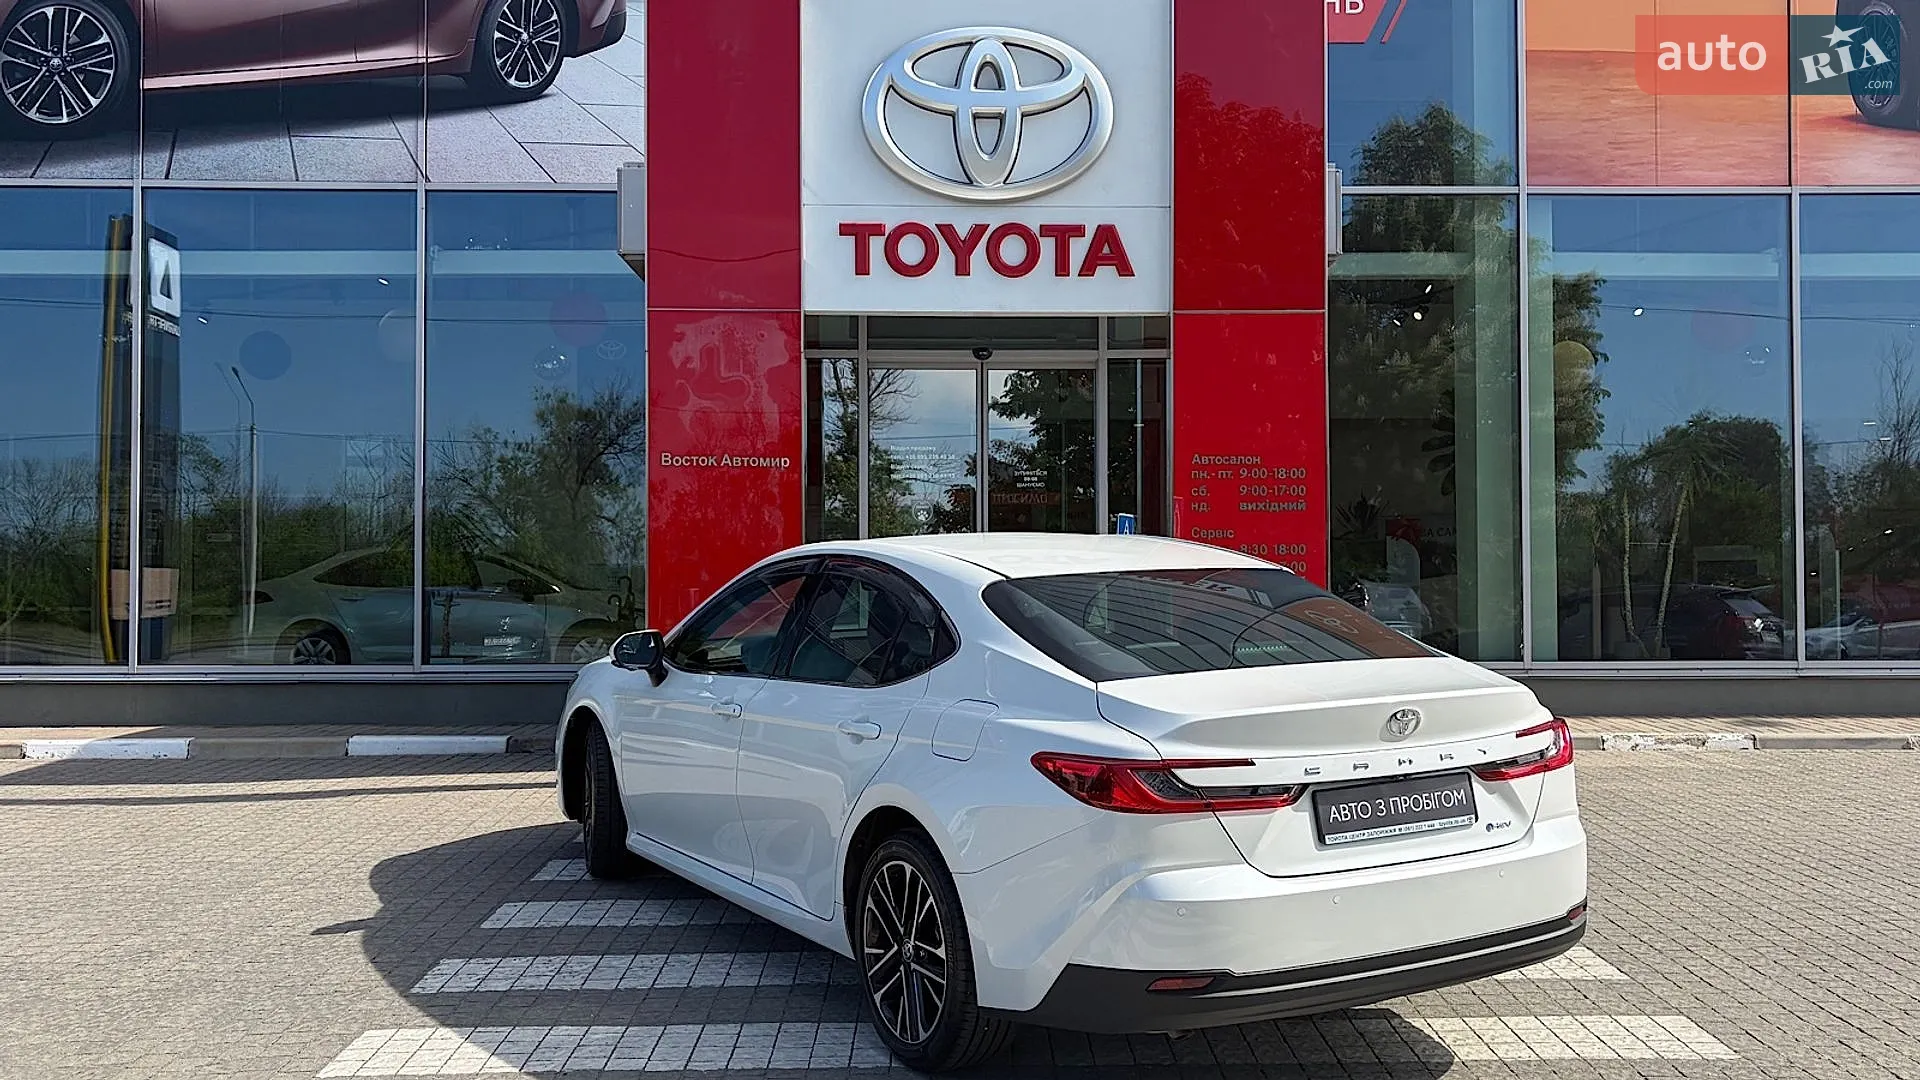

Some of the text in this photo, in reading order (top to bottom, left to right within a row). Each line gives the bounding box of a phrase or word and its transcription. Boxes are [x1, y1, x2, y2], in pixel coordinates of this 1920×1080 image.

[838, 221, 1136, 278] TOYOTA
[660, 452, 790, 470] Восток Автомир
[1191, 453, 1261, 465] Автосалон
[1191, 484, 1307, 497] сб. 9:00-17:00
[1239, 500, 1307, 513] вихідний
[1191, 527, 1235, 540] Сервіс
[1329, 800, 1372, 824] АВТО
[1390, 788, 1467, 815] ПРОБІГОМ
